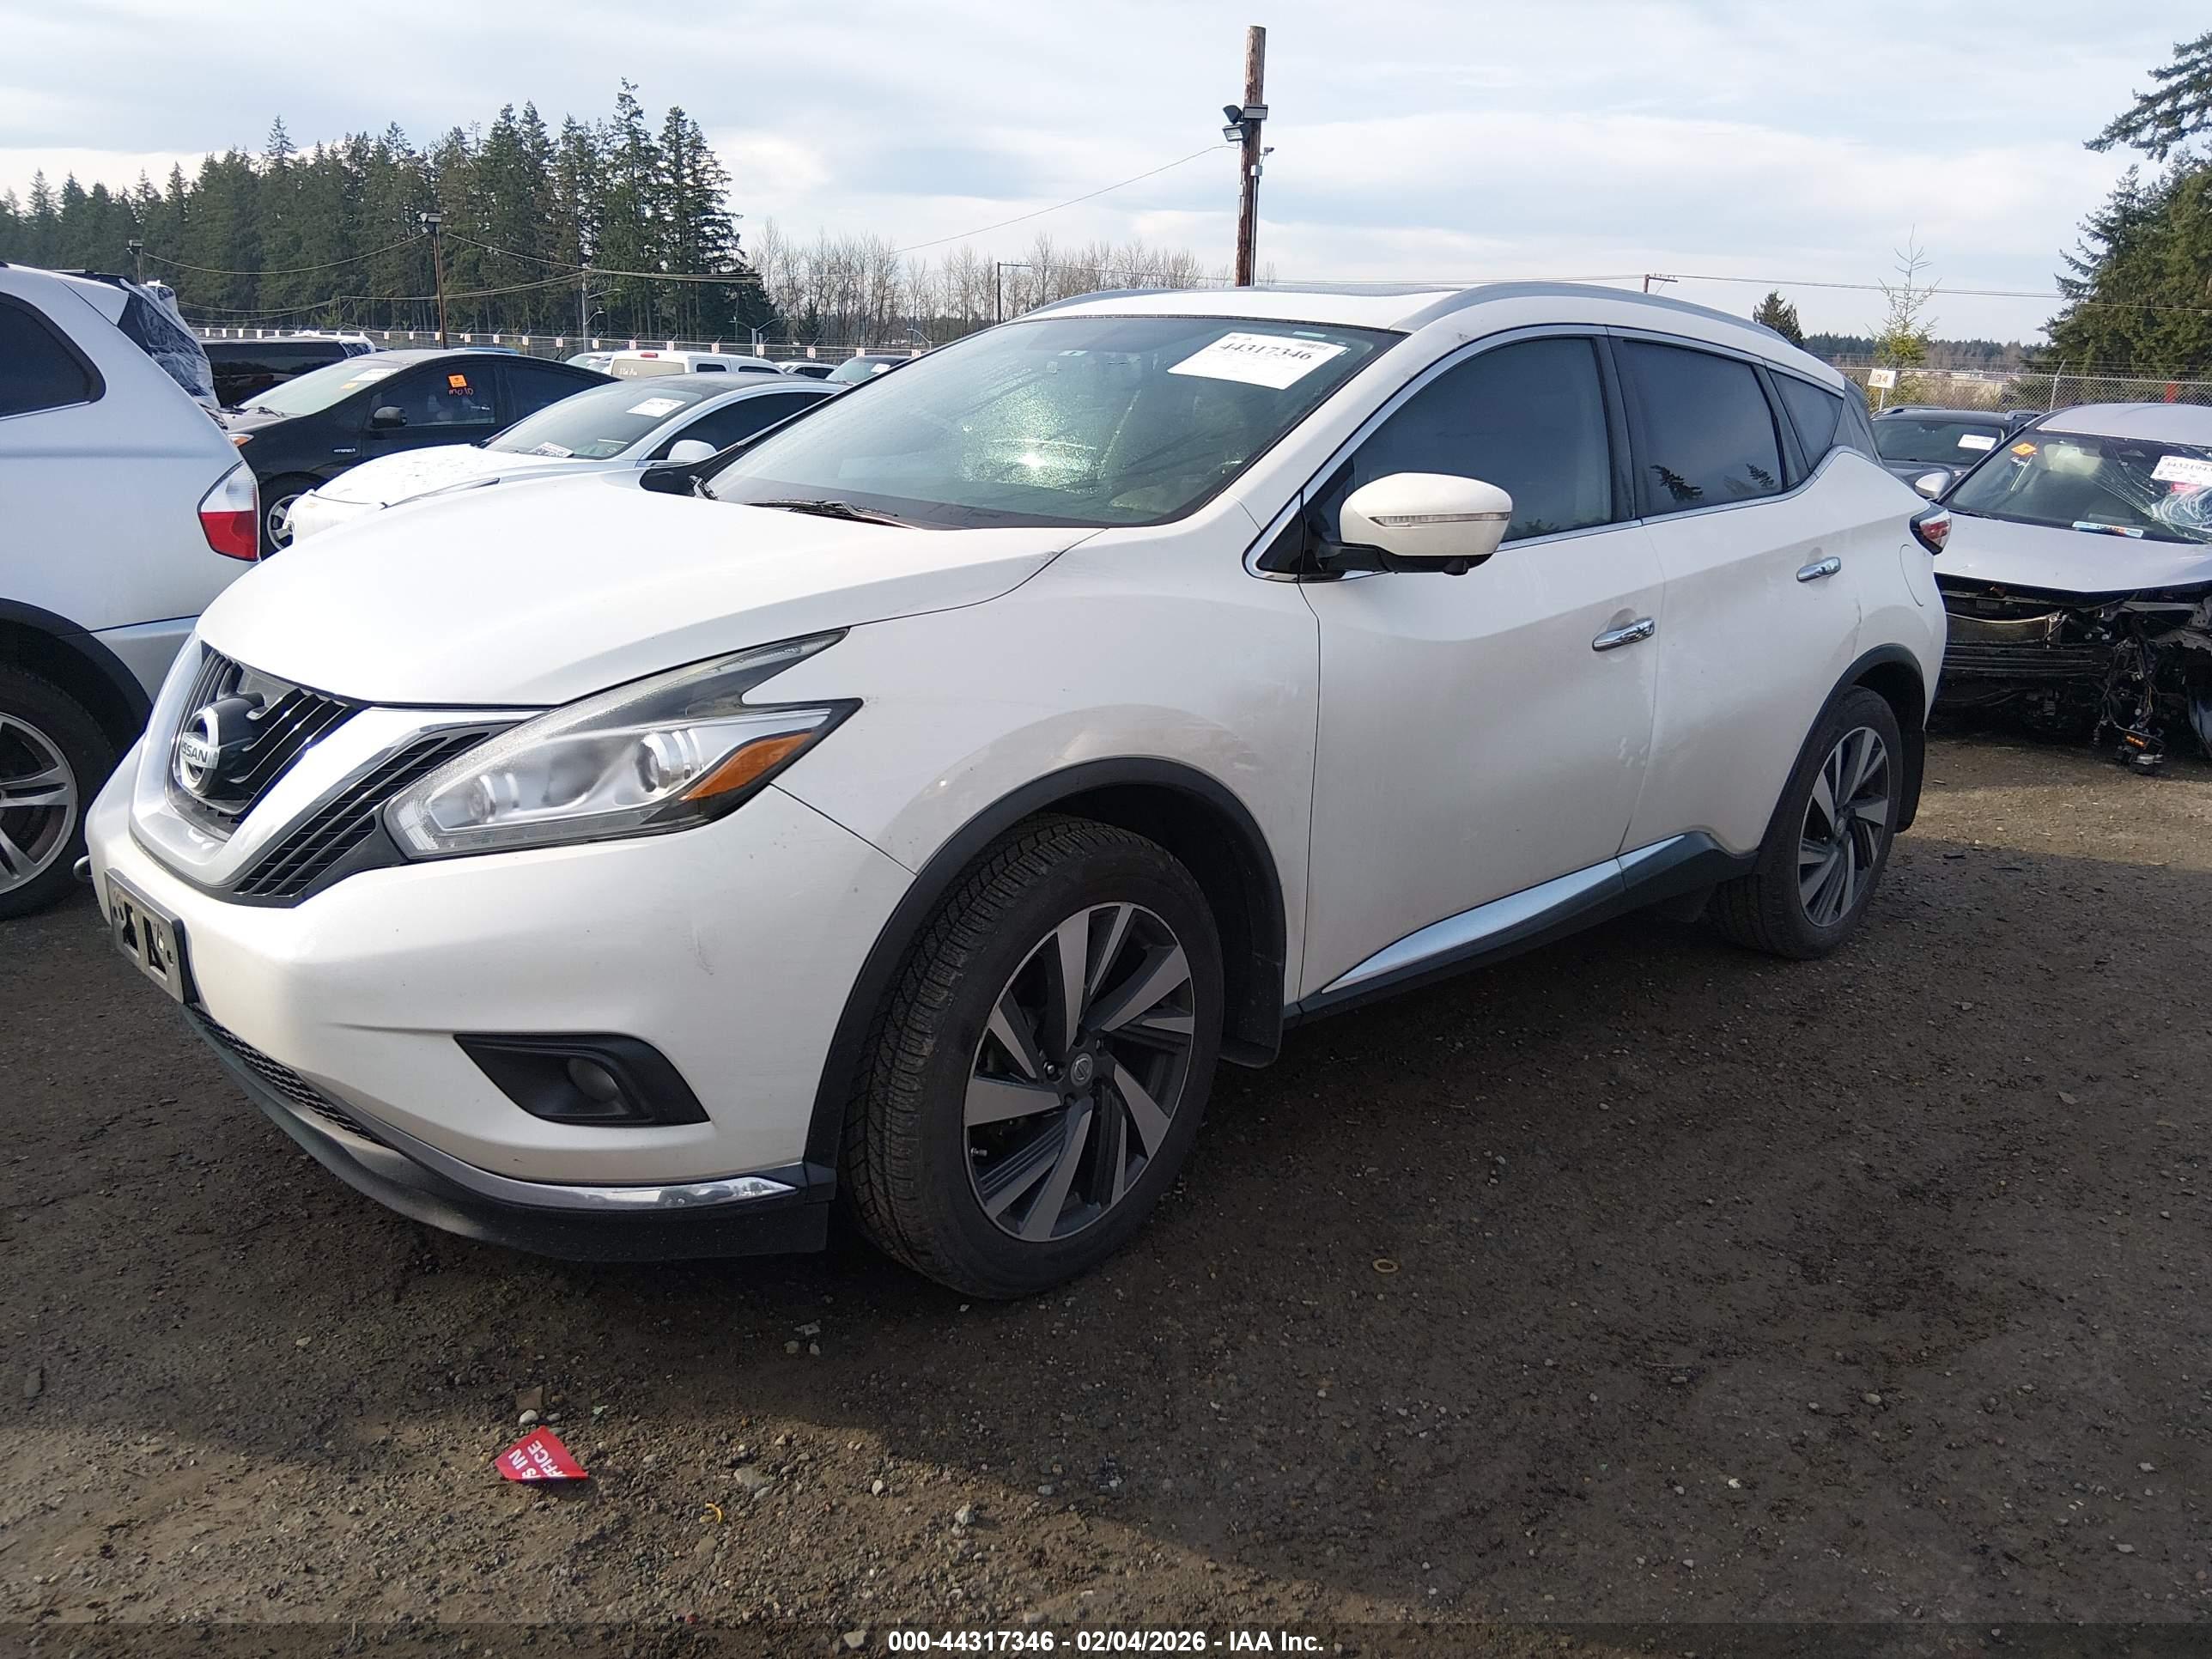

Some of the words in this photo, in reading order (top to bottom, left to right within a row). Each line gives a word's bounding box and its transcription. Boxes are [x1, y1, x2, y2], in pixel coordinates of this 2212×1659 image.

[1219, 343, 1314, 361] 44317346
[508, 1449, 528, 1470] IN
[527, 1440, 567, 1477] FFICE
